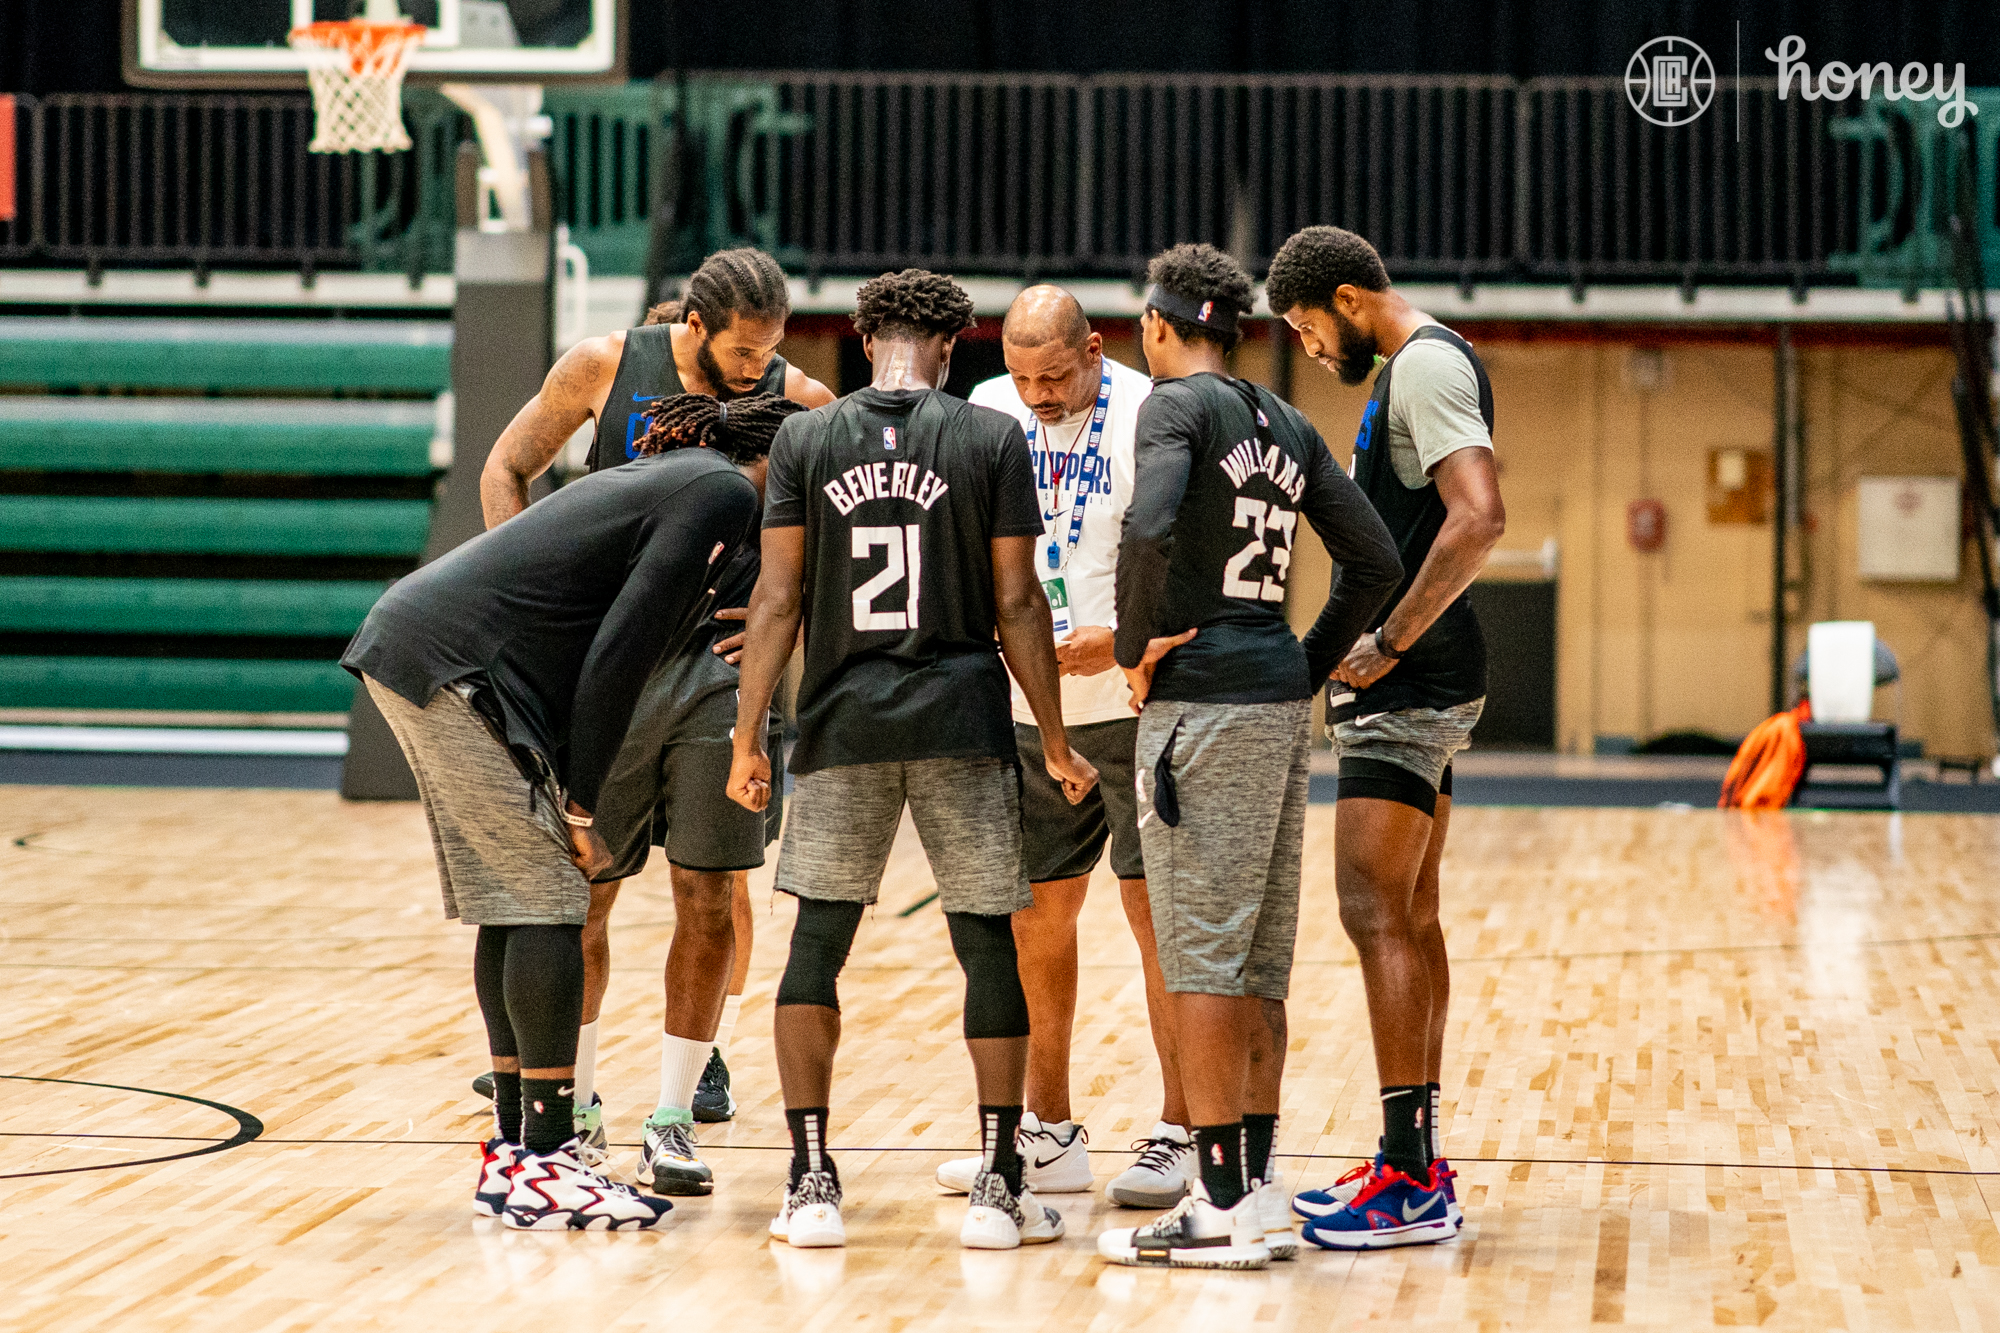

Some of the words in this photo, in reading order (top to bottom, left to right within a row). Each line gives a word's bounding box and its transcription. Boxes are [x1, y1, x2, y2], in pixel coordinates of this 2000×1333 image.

[1094, 407, 1107, 420] NBA
[1089, 431, 1101, 444] NBA
[1032, 450, 1112, 495] LIPPRS
[1084, 456, 1096, 468] NBA
[1219, 438, 1306, 504] WILLAMS
[823, 461, 949, 516] BEVERLEY
[1079, 480, 1090, 492] NBA
[1073, 505, 1085, 517] NBA
[1222, 496, 1298, 603] 23
[852, 524, 921, 631] 21
